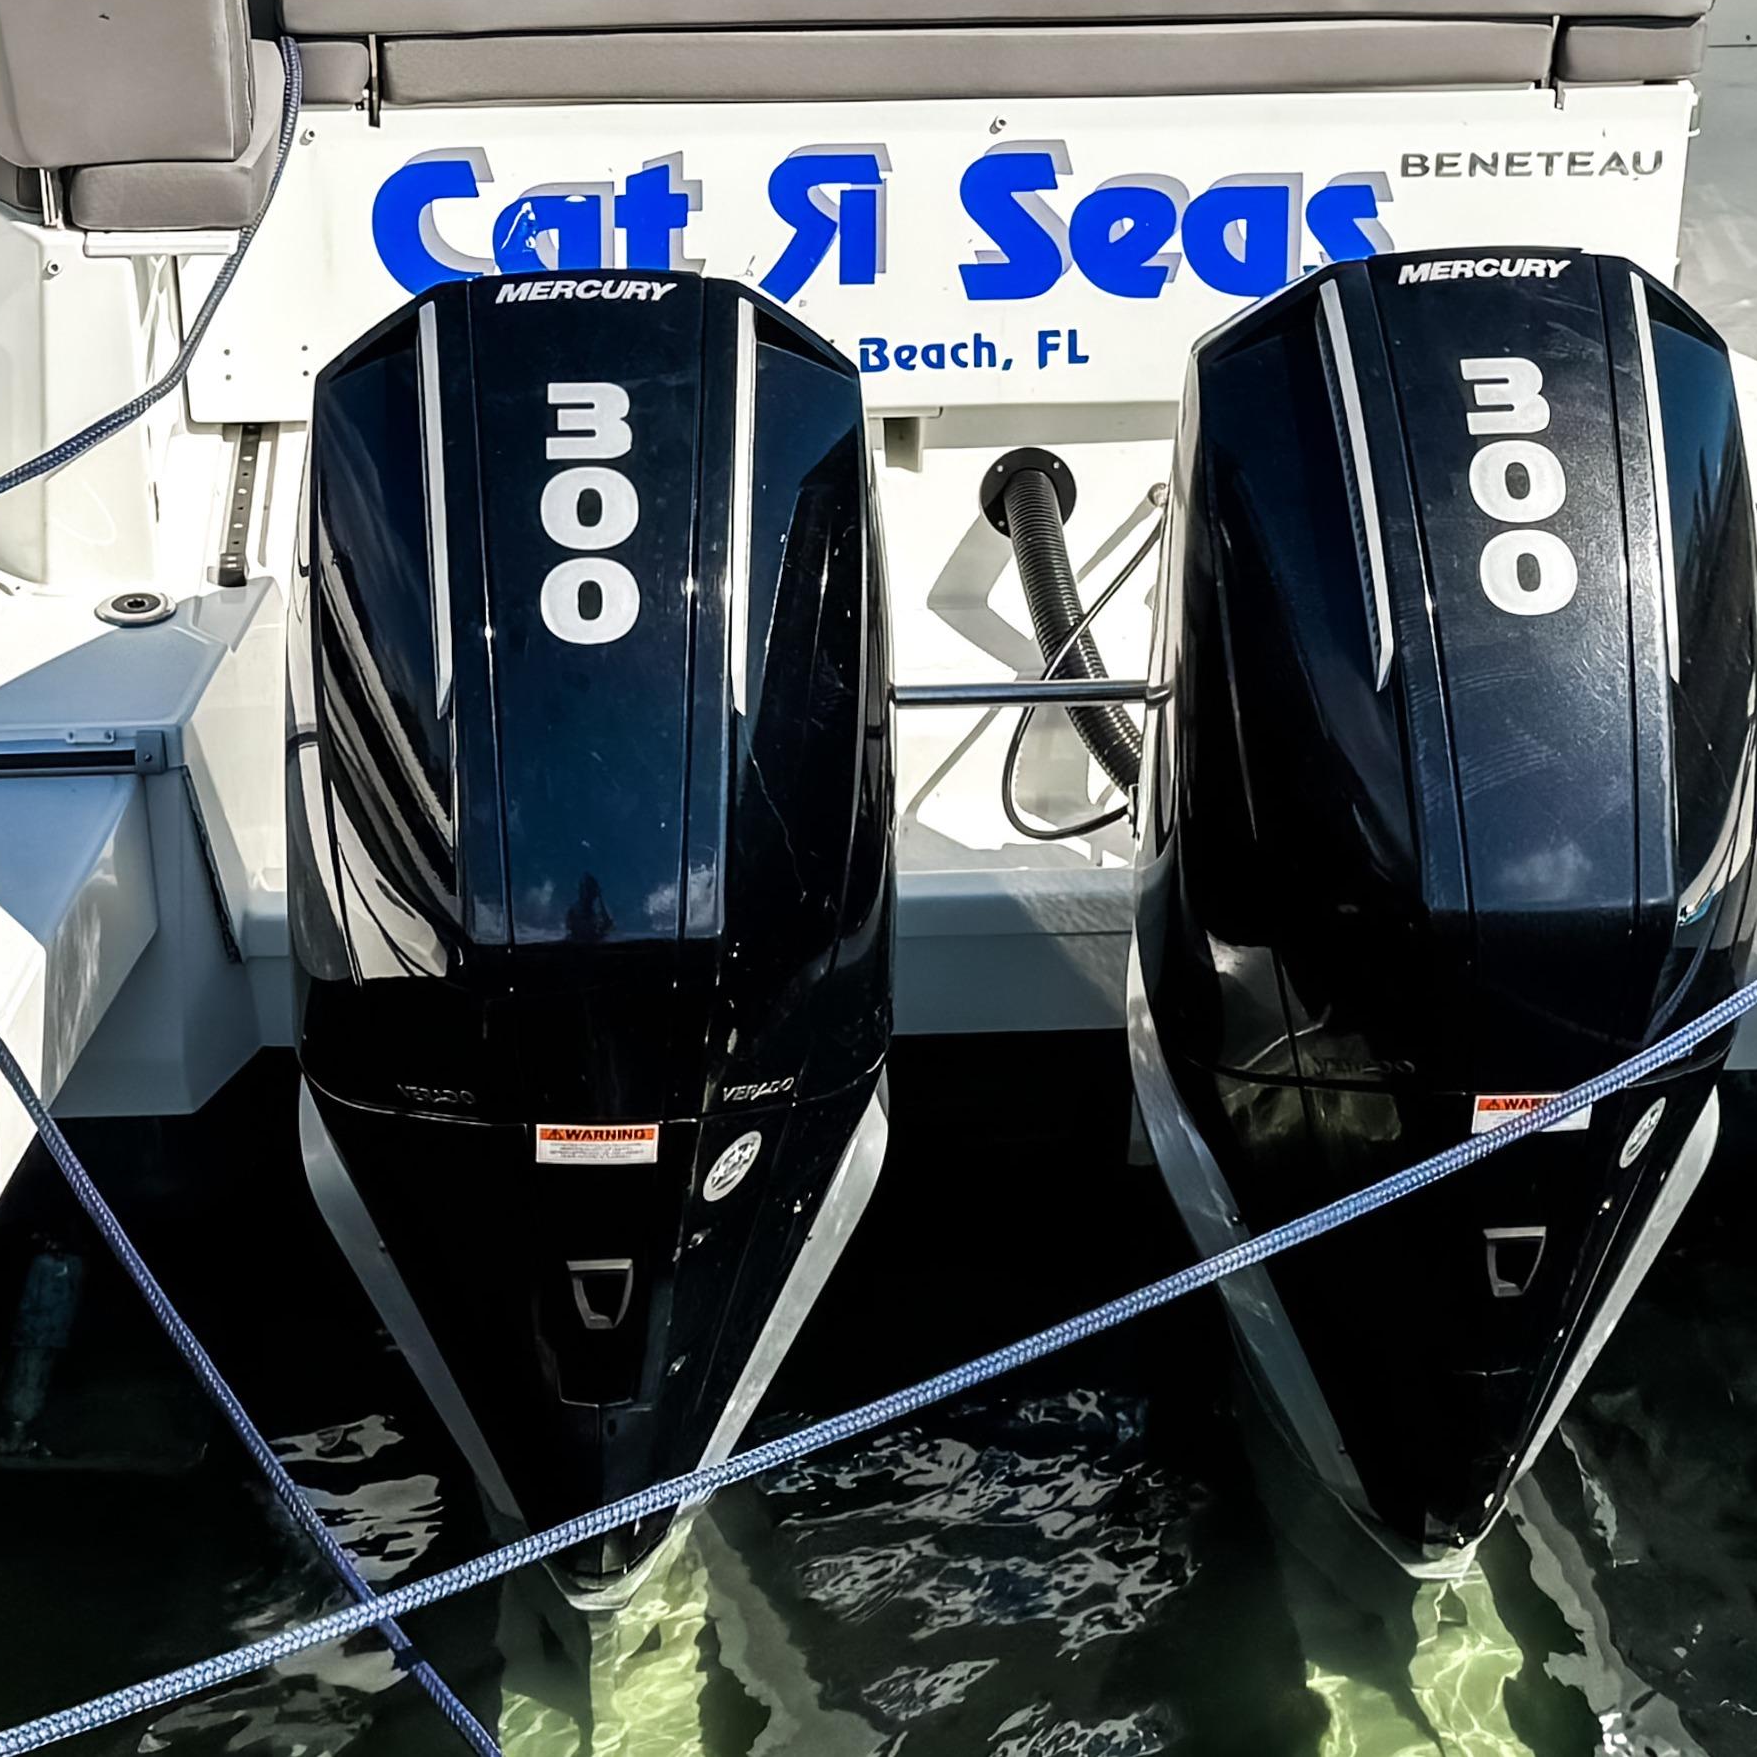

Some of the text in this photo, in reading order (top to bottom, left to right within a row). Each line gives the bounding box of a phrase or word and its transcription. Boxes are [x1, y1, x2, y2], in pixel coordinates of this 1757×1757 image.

[1400, 150, 1663, 178] BENETEAU
[372, 146, 706, 296] Cat
[958, 139, 1395, 300] Seas
[1398, 258, 1572, 285] MERCURY
[495, 279, 678, 304] MERCURY
[859, 329, 1090, 373] Beach, FL
[1459, 357, 1578, 617] 300
[540, 382, 641, 646] 300
[565, 1129, 646, 1141] WARNING
